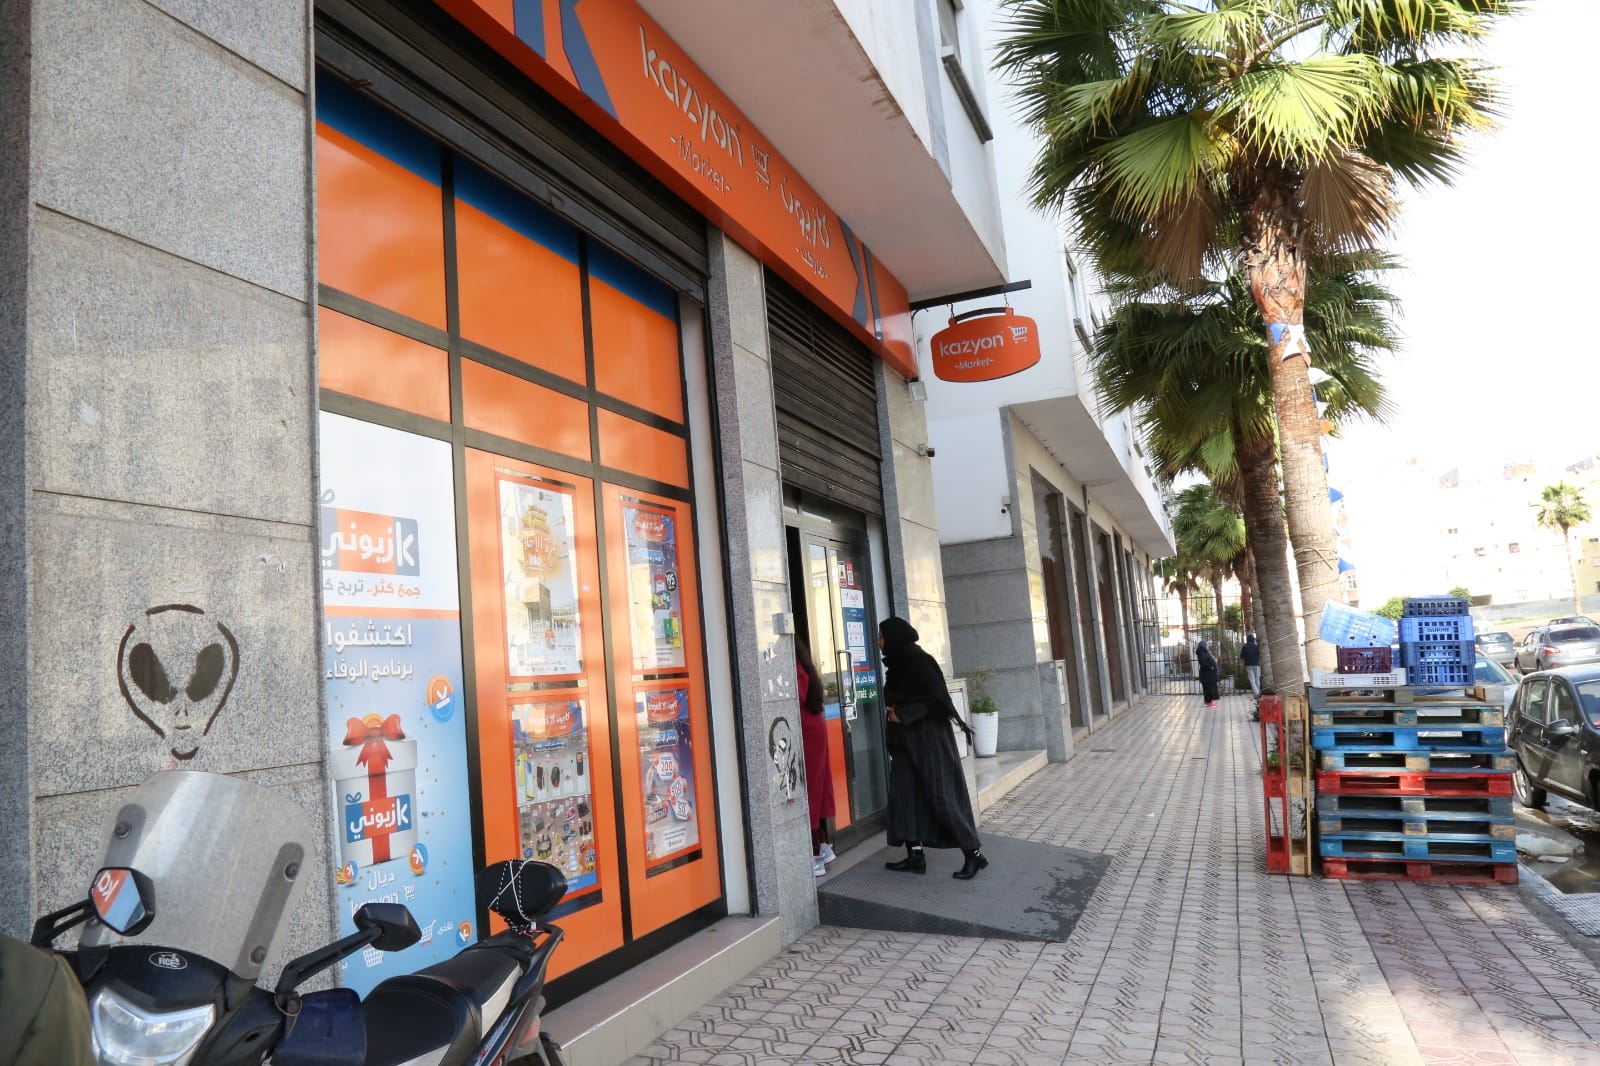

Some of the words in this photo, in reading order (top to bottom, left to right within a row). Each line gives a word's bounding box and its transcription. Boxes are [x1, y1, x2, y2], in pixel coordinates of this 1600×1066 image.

[640, 24, 744, 167] kazyon
[939, 331, 1005, 358] kazyon
[326, 620, 413, 652] اكتشفوا
[326, 659, 369, 681] الوفاء
[371, 658, 414, 681] برنامج
[368, 869, 396, 891] ديال
